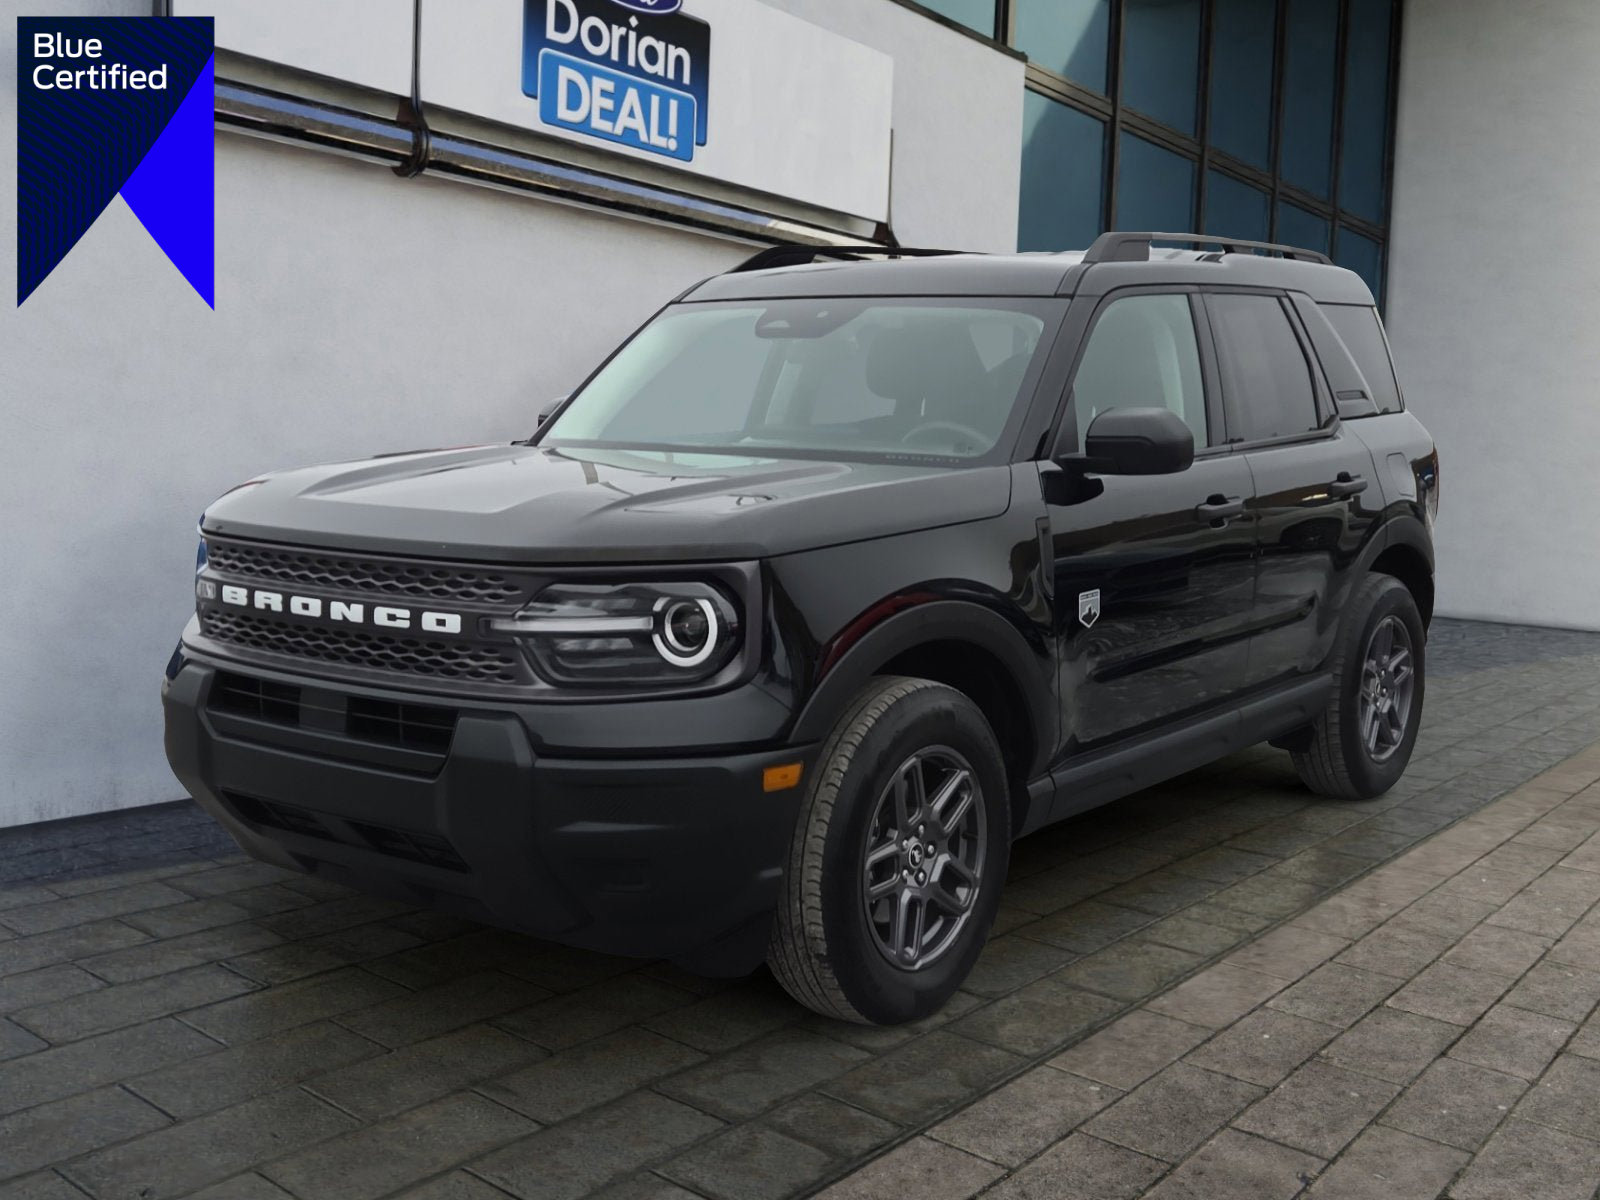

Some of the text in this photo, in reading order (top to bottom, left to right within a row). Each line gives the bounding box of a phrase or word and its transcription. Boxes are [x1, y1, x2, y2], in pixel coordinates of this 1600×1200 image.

[546, 0, 691, 85] Dorian
[557, 64, 678, 151] DEAL!
[222, 584, 462, 634] BRONCO
